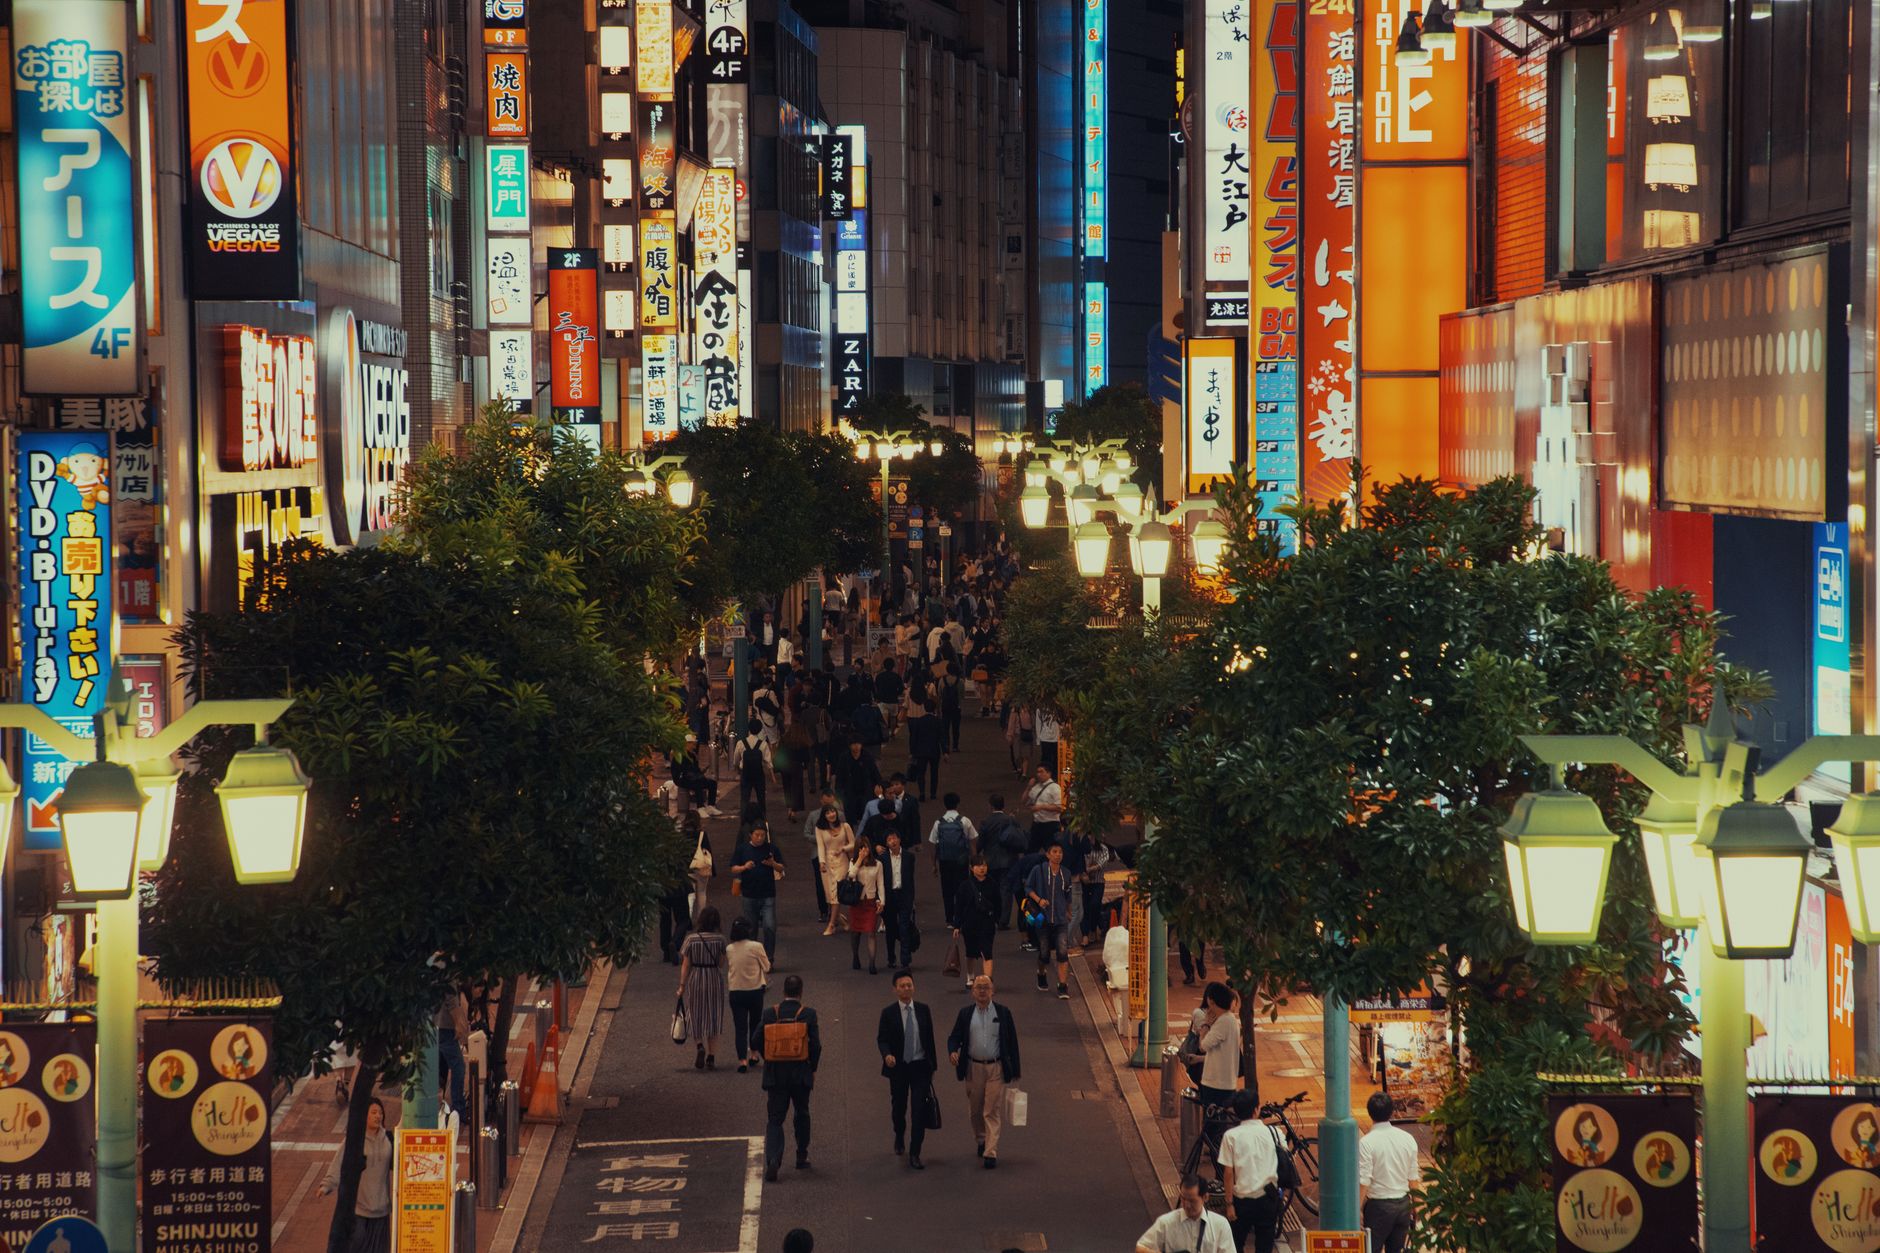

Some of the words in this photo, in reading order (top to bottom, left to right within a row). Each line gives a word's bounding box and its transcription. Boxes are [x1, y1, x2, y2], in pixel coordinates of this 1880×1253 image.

[712, 29, 743, 53] 4F
[19, 42, 122, 87] お部屋
[1216, 51, 1233, 61] 2階
[609, 67, 622, 75] 5F
[712, 60, 742, 77] 4F
[38, 80, 123, 115] 探しは
[492, 62, 521, 120] 焼肉
[610, 132, 623, 141] 4F
[831, 142, 844, 183] メガネ
[1221, 143, 1249, 232] 大江戸
[611, 199, 624, 207] 3F
[41, 128, 109, 310] アース
[206, 229, 280, 242] VEGAS
[207, 240, 280, 252] VEGAS
[563, 252, 582, 268] 2F
[644, 246, 672, 316] 腹八分目
[644, 315, 657, 324] 4F
[89, 327, 132, 359] 4F
[568, 345, 583, 400] DINING
[843, 339, 863, 410] ZARA
[1256, 362, 1278, 373] 4F
[362, 363, 410, 449] VEGAS
[568, 408, 585, 424] 1F
[1256, 402, 1278, 413] 3F
[1256, 441, 1278, 452] 2F
[121, 580, 151, 606] 1階
[150, 1166, 265, 1186] 歩行者用道路
[1563, 1185, 1634, 1222] Hello
[156, 1222, 259, 1241] SHINJUKU
